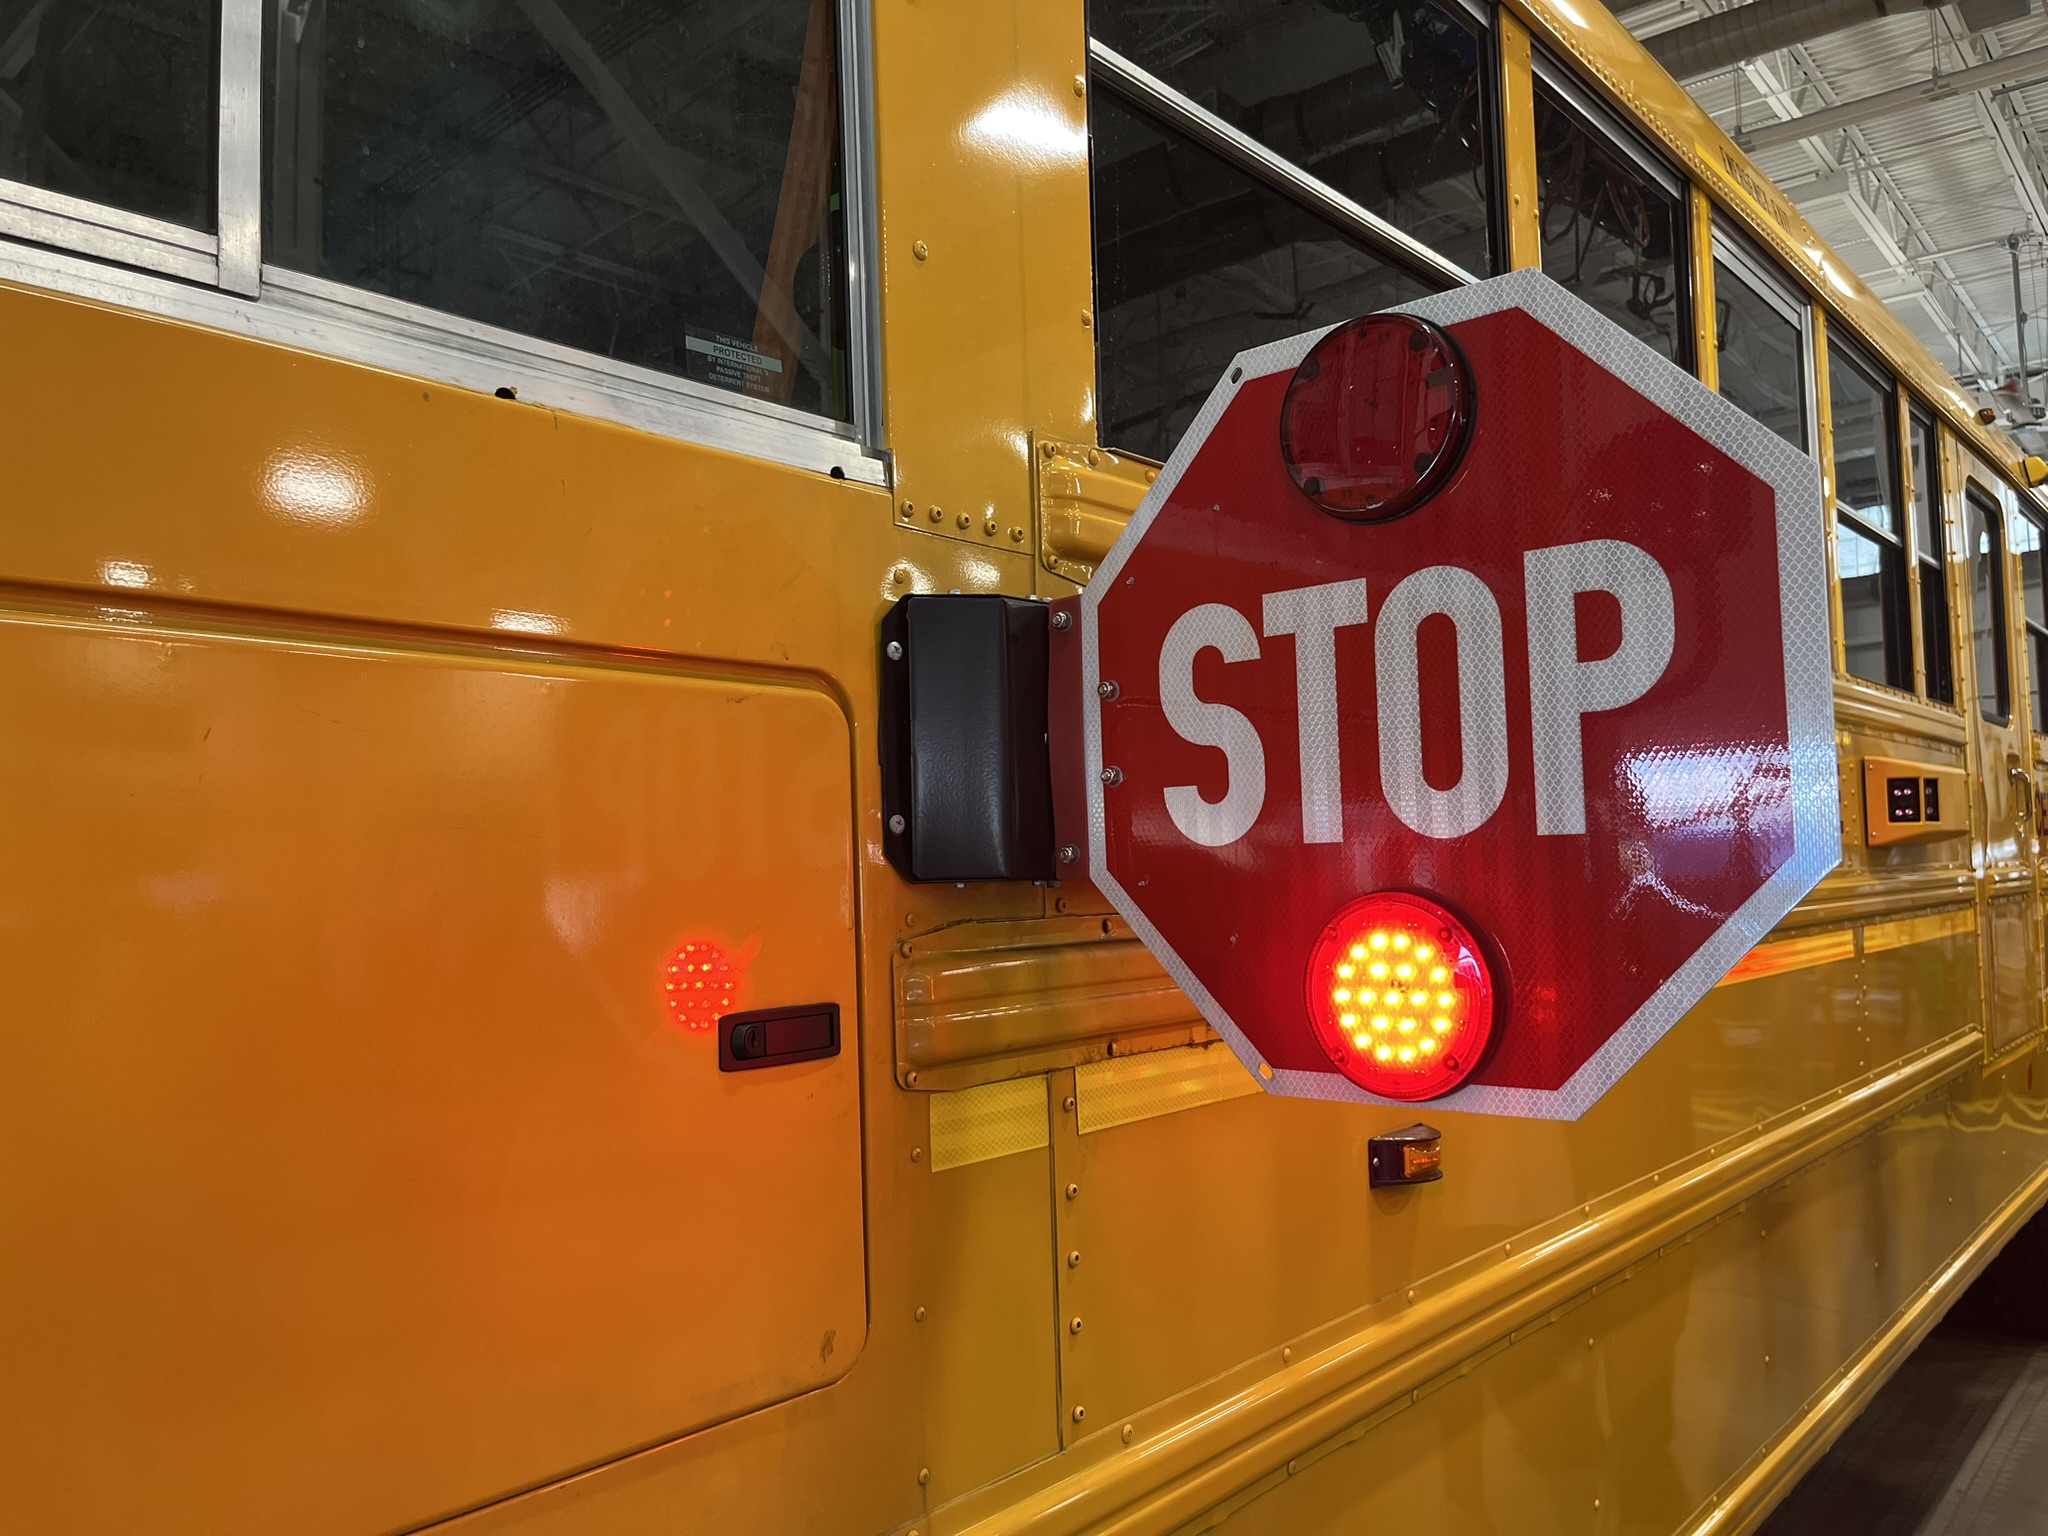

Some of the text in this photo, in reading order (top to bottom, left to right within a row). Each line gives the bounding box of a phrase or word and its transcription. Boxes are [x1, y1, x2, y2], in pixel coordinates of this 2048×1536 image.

[715, 334, 759, 352] THIS VEHICLE
[707, 354, 769, 376] BY INTERNATIONAL'S
[713, 345, 762, 365] PROTECTED
[708, 372, 770, 393] DETERRENT SYSTEM
[716, 366, 761, 382] PASSIVE THEFT
[1158, 538, 1676, 847] STOP
